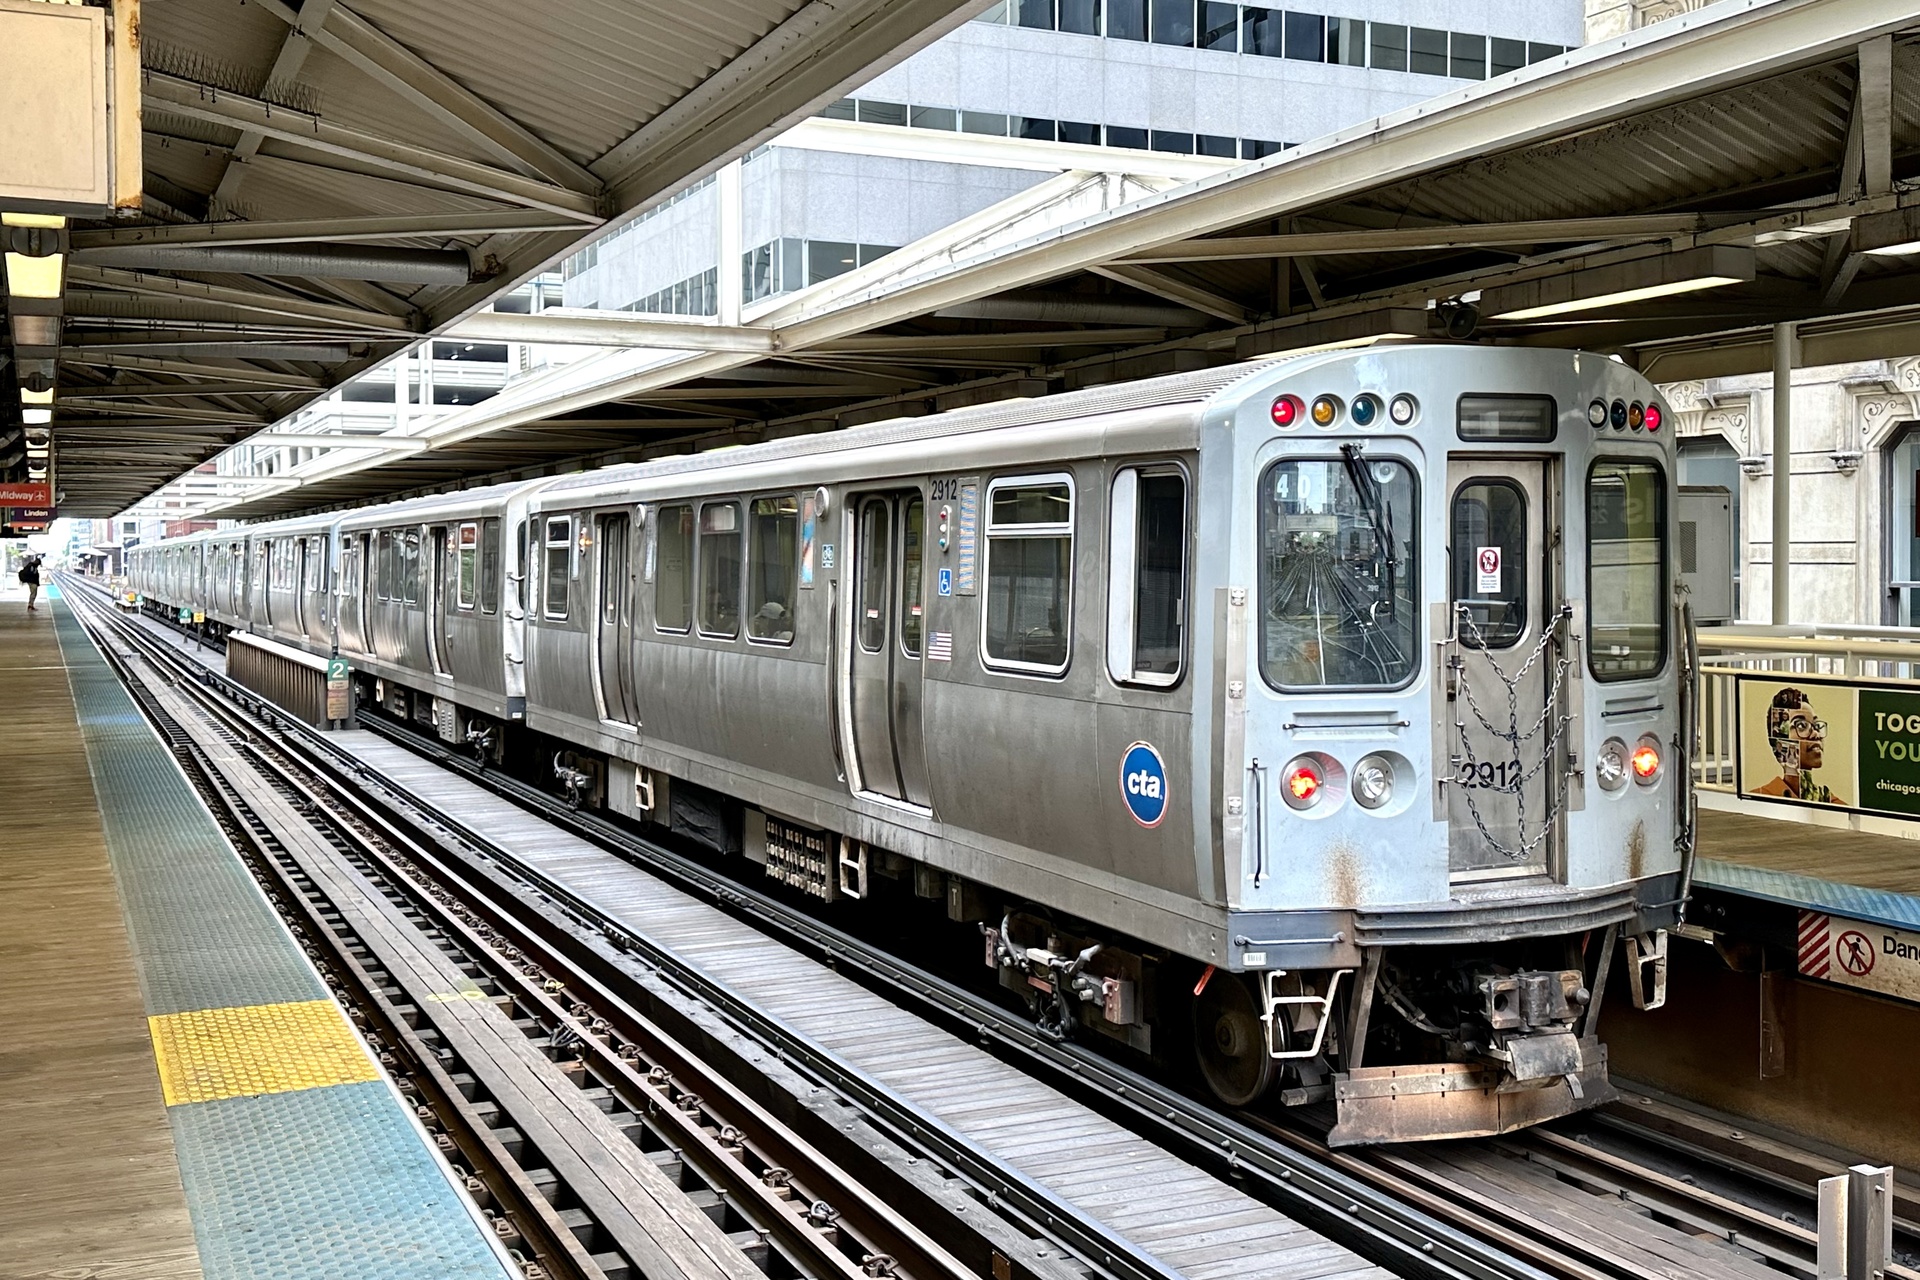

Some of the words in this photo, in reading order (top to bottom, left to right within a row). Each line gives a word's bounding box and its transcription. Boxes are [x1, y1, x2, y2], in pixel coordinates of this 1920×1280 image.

[931, 479, 957, 500] 2912
[182, 609, 188, 618] 4
[332, 662, 344, 678] 2
[1875, 712, 1920, 734] TOG
[1875, 740, 1920, 762] YOU
[1127, 769, 1160, 798] cta
[1461, 760, 1522, 788] 2912
[1876, 779, 1920, 795] chicagos
[1883, 935, 1920, 960] Dan
